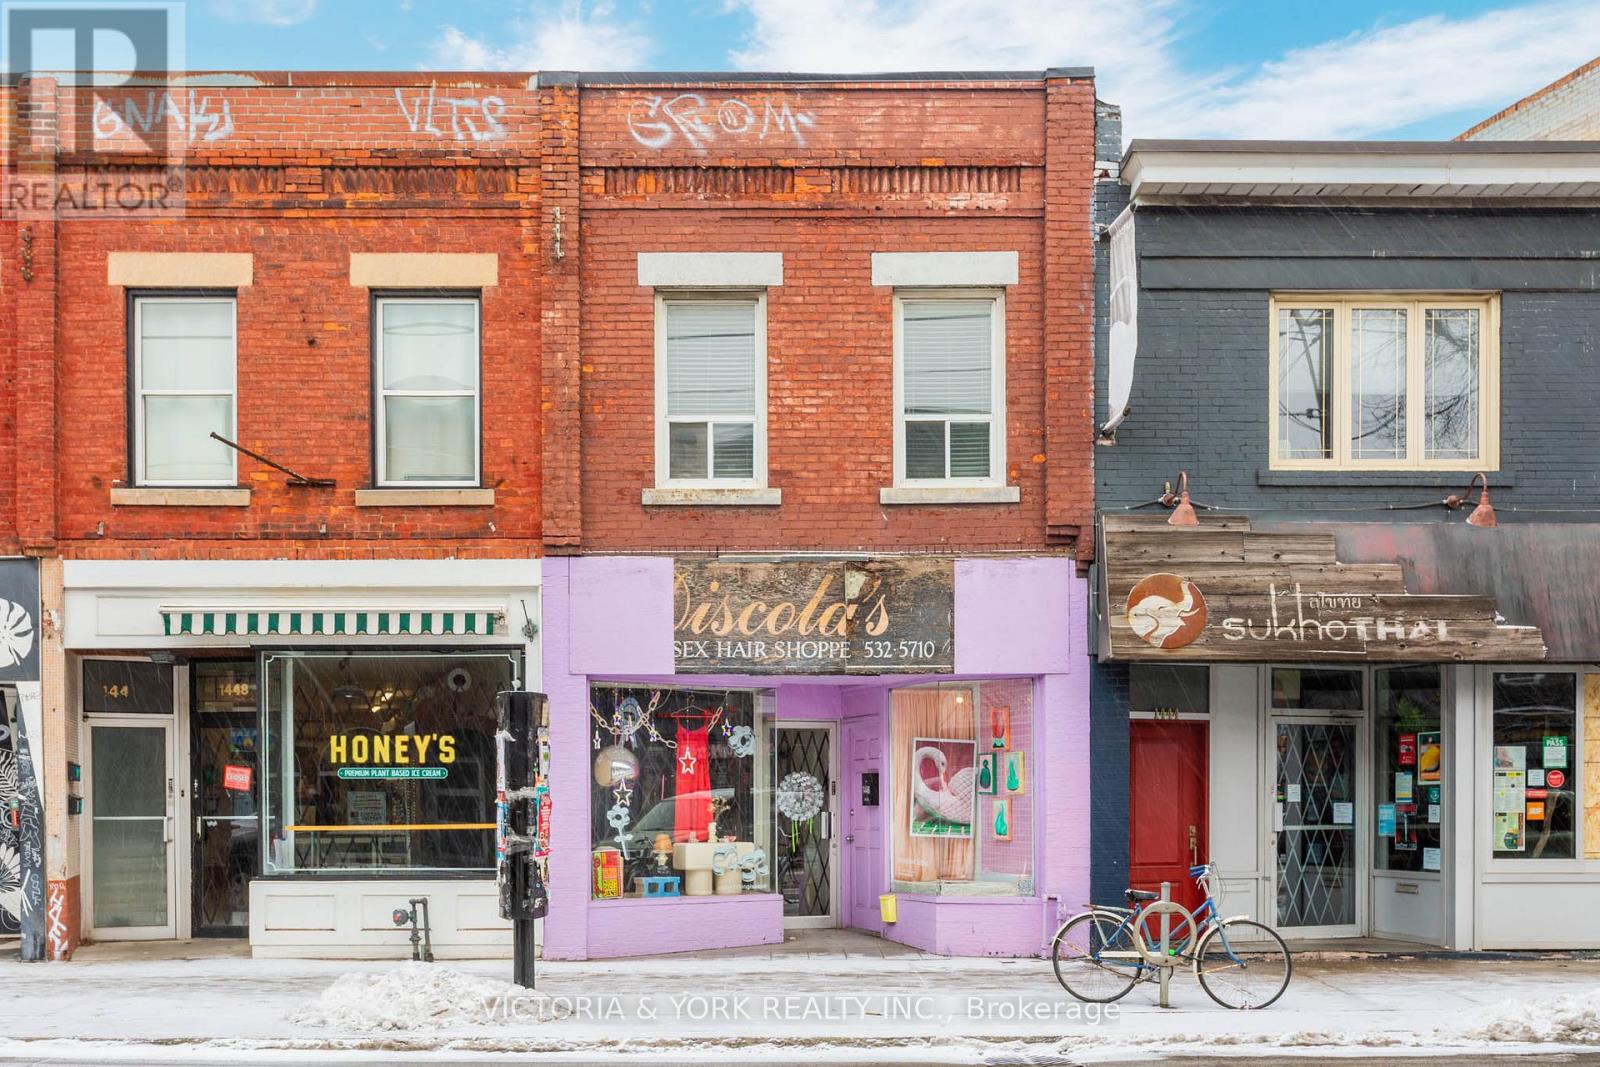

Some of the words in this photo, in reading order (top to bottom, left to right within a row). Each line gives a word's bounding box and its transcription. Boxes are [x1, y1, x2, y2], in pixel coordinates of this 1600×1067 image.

[717, 640, 767, 658] HAIR
[774, 640, 851, 659] SHOPPE
[330, 733, 456, 764] HONEY'S
[344, 769, 370, 777] PREMIUM
[371, 769, 390, 777] PLANT
[391, 769, 410, 777] BASED
[411, 769, 420, 777] ICE
[421, 769, 442, 777] CREAM
